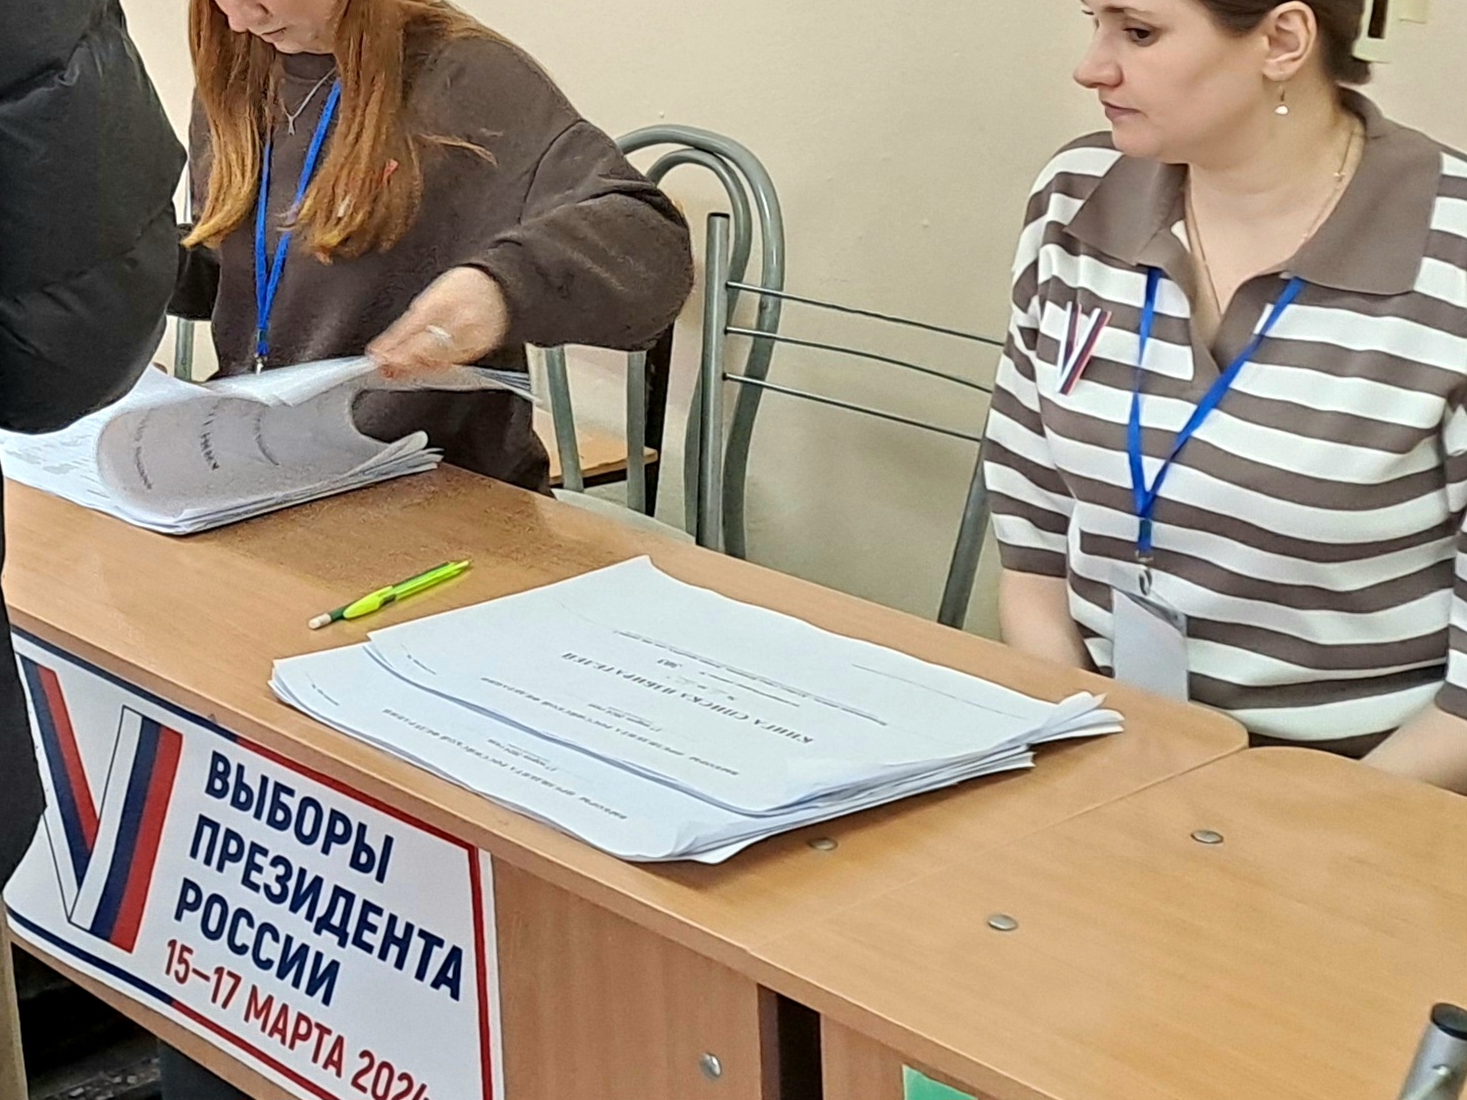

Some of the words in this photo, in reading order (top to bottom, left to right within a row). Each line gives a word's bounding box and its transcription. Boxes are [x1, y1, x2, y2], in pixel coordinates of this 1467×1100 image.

[204, 750, 394, 883] ВЫБОРЫ
[174, 877, 341, 1006] РОССИИ
[189, 814, 465, 1002] ПРЕЗИДЕНТА
[164, 938, 242, 1011] 15–17
[244, 985, 345, 1078] МАРТА
